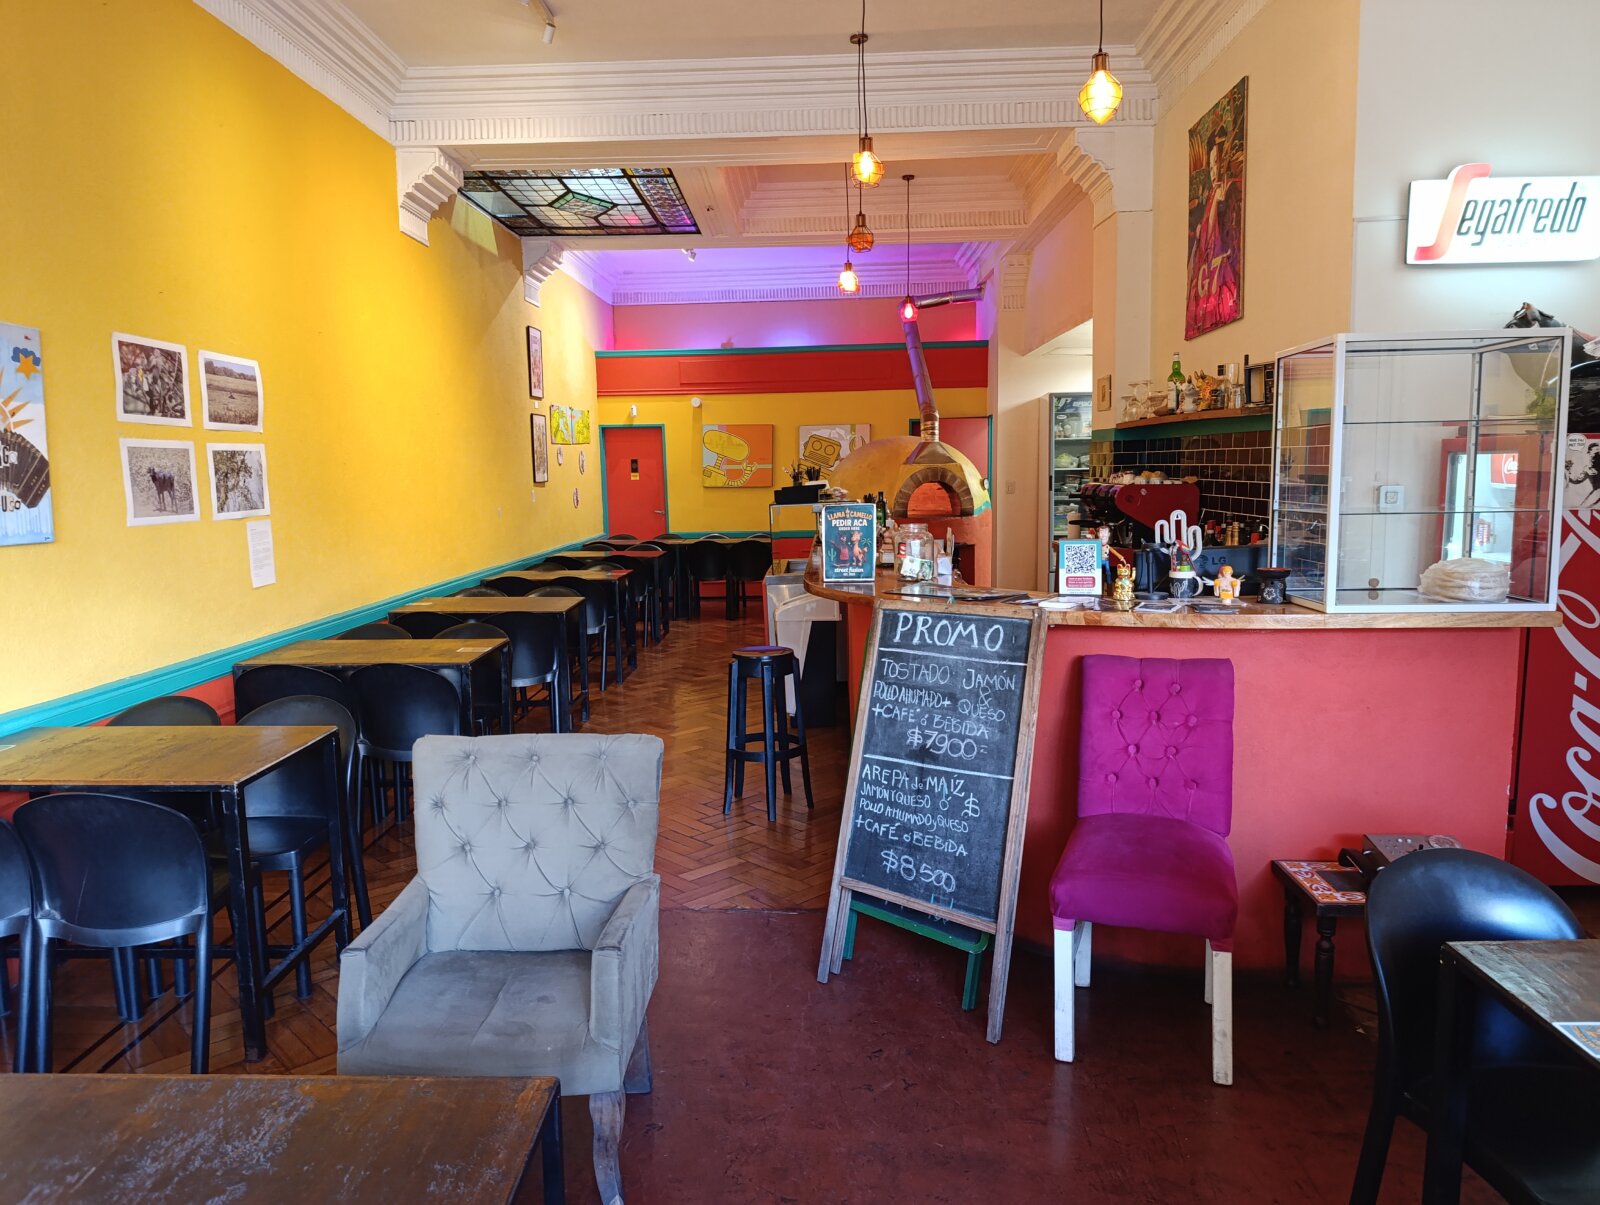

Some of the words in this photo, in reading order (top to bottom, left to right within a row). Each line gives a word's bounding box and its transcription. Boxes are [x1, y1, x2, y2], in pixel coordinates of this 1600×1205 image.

[1414, 162, 1587, 261] Segafredo
[827, 511, 845, 520] LLAMA
[850, 511, 873, 520] CAMELLO
[832, 519, 851, 527] PEDIR
[1211, 557, 1226, 565] LG
[893, 612, 1004, 651] PROMO
[881, 658, 950, 685] TOSTADO
[958, 699, 1005, 722] QUESO
[933, 714, 989, 739] BEBIDA
[862, 763, 910, 790] AREPA
[911, 777, 924, 790] de
